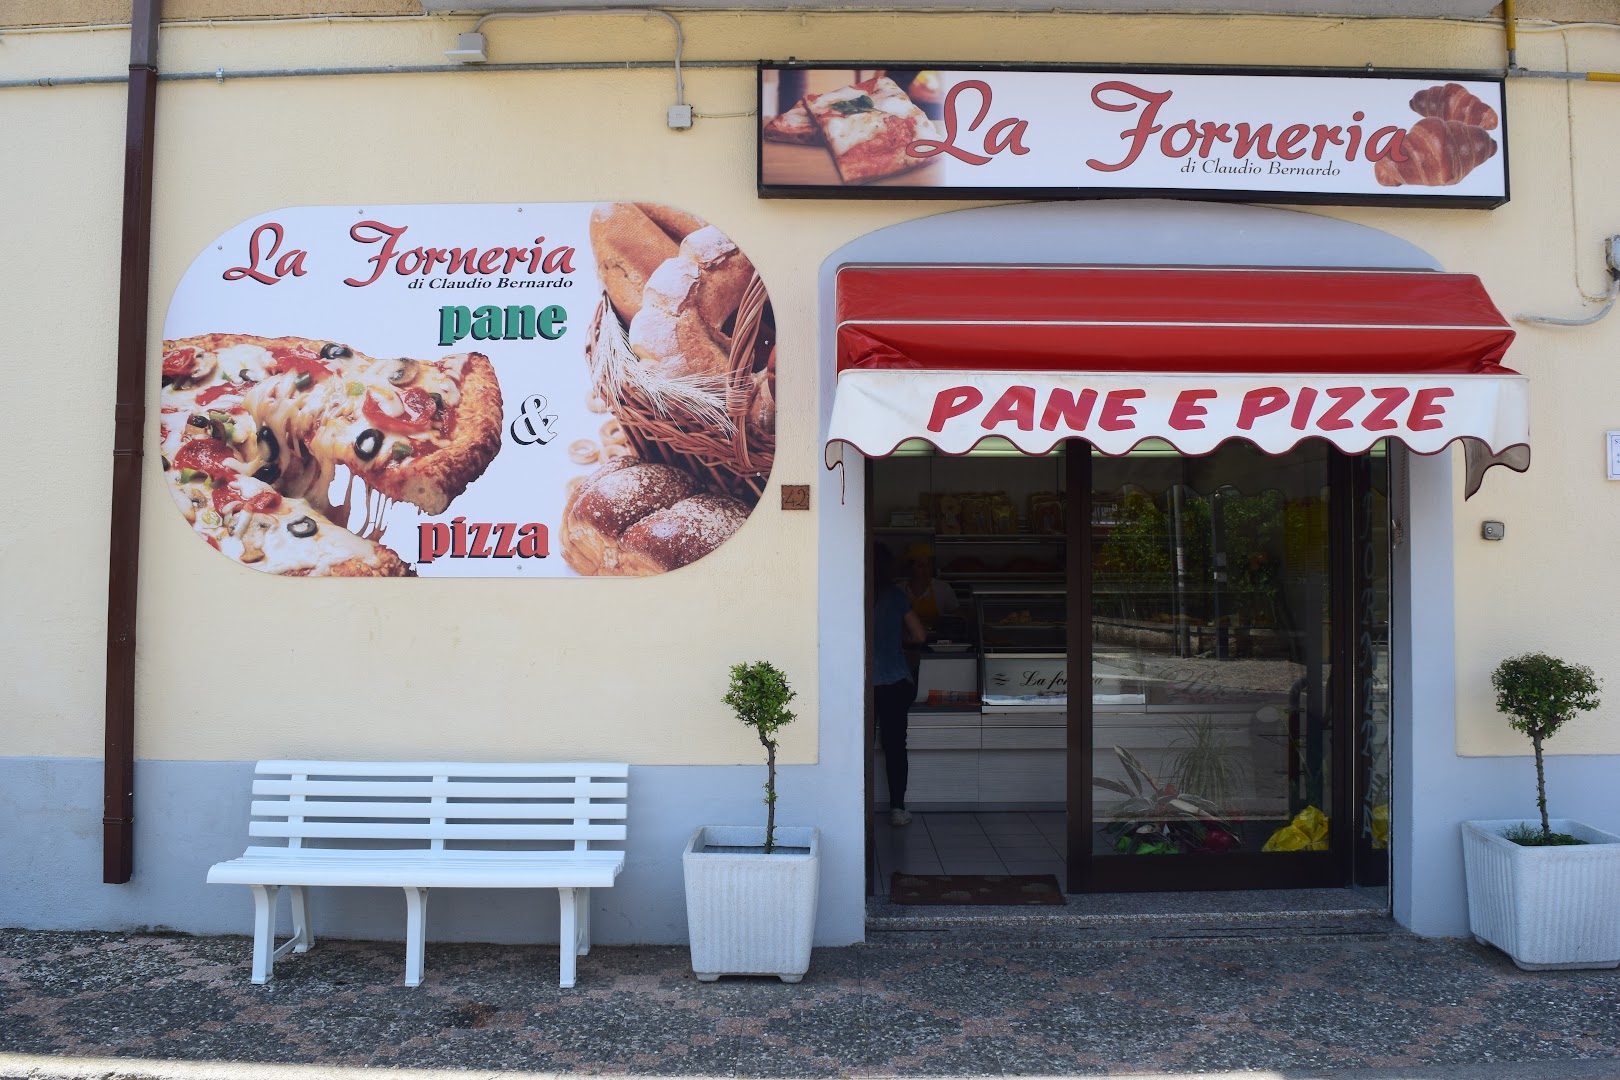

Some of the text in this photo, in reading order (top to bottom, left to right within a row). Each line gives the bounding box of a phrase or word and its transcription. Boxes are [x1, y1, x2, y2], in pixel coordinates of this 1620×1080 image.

[906, 80, 1410, 172] La Forneria
[1180, 158, 1341, 177] di Claudio Bernardo
[222, 220, 577, 288] La Forneria
[407, 276, 574, 290] di Claudio Bernardo
[438, 303, 568, 347] pane
[510, 393, 560, 446] &
[927, 386, 1455, 433] PANE E PIZZE
[784, 488, 806, 507] 42
[417, 516, 550, 564] pizza
[1019, 670, 1046, 687] La
